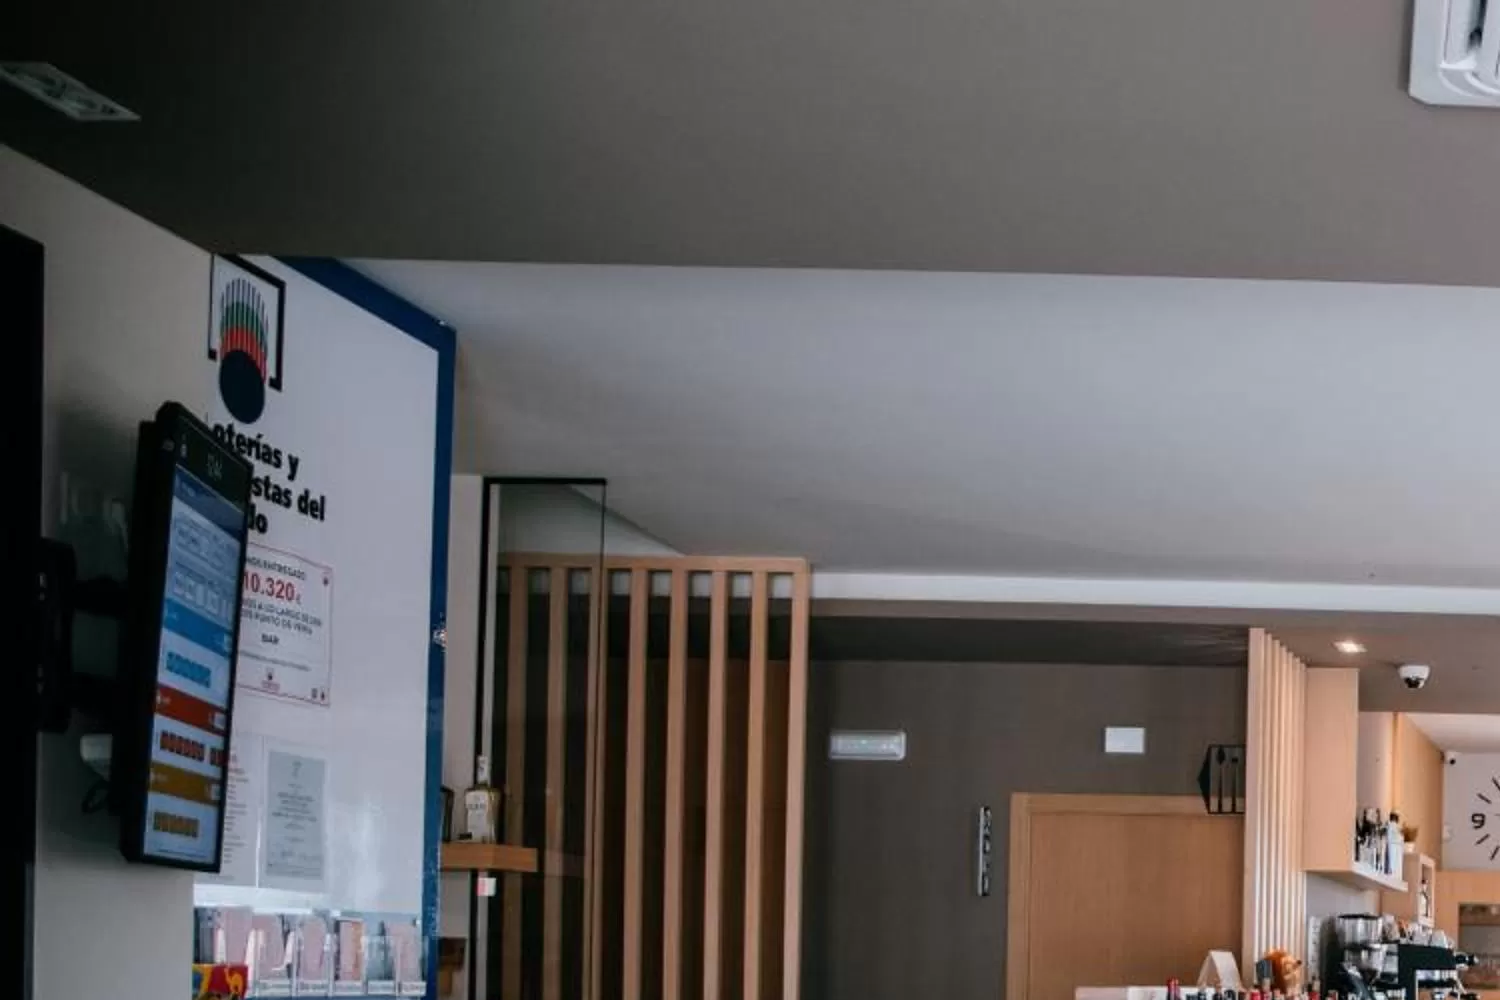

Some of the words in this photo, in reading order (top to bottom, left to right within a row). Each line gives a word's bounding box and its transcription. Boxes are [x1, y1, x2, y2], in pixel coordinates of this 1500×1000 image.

[287, 453, 299, 481] y
[297, 488, 325, 522] del
[1471, 813, 1486, 830] 9
